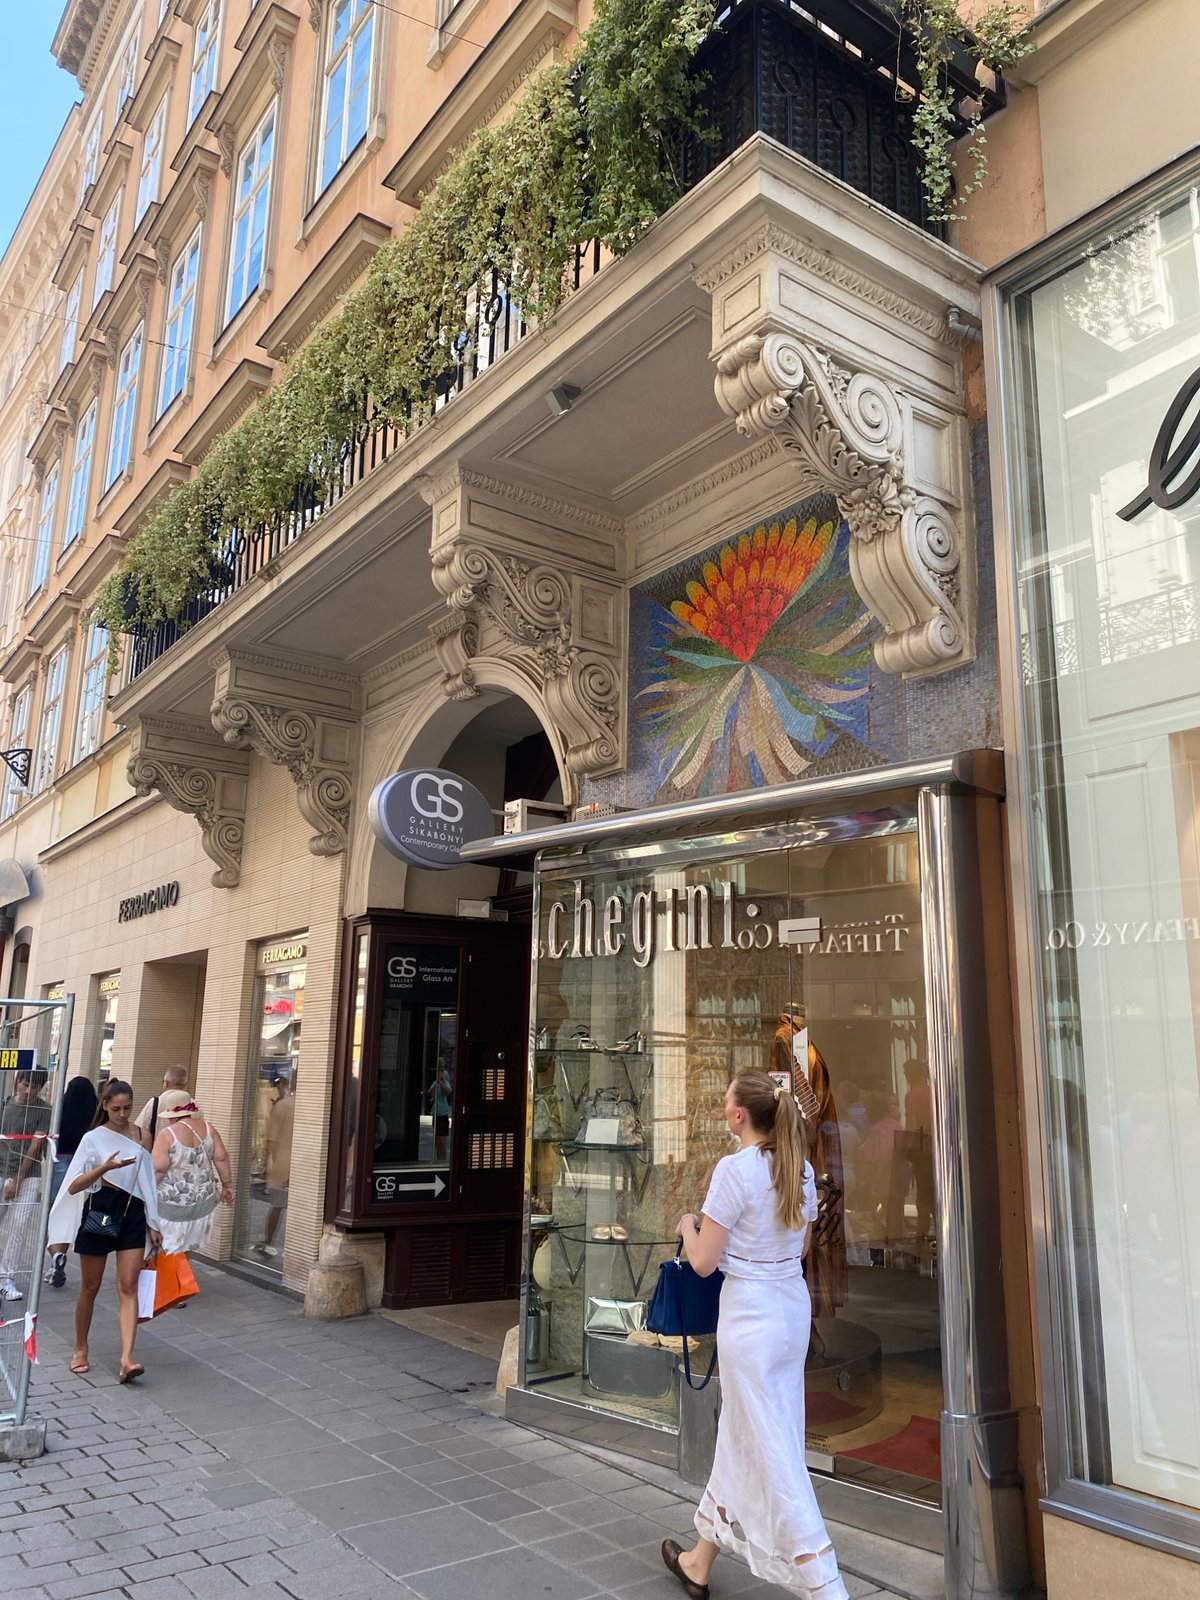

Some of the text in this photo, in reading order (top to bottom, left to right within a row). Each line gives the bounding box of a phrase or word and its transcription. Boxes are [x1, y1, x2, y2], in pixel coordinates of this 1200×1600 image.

[410, 772, 464, 823] GS
[409, 816, 464, 834] GALLERY
[400, 834, 448, 852] Contemporary
[409, 826, 464, 844] SIKABONYI
[118, 880, 179, 923] FERRAGAMO
[262, 944, 303, 964] FERRAGAMO
[387, 956, 417, 978] GS
[419, 966, 457, 974] International
[422, 974, 441, 982] Glass
[375, 1176, 396, 1191] GS
